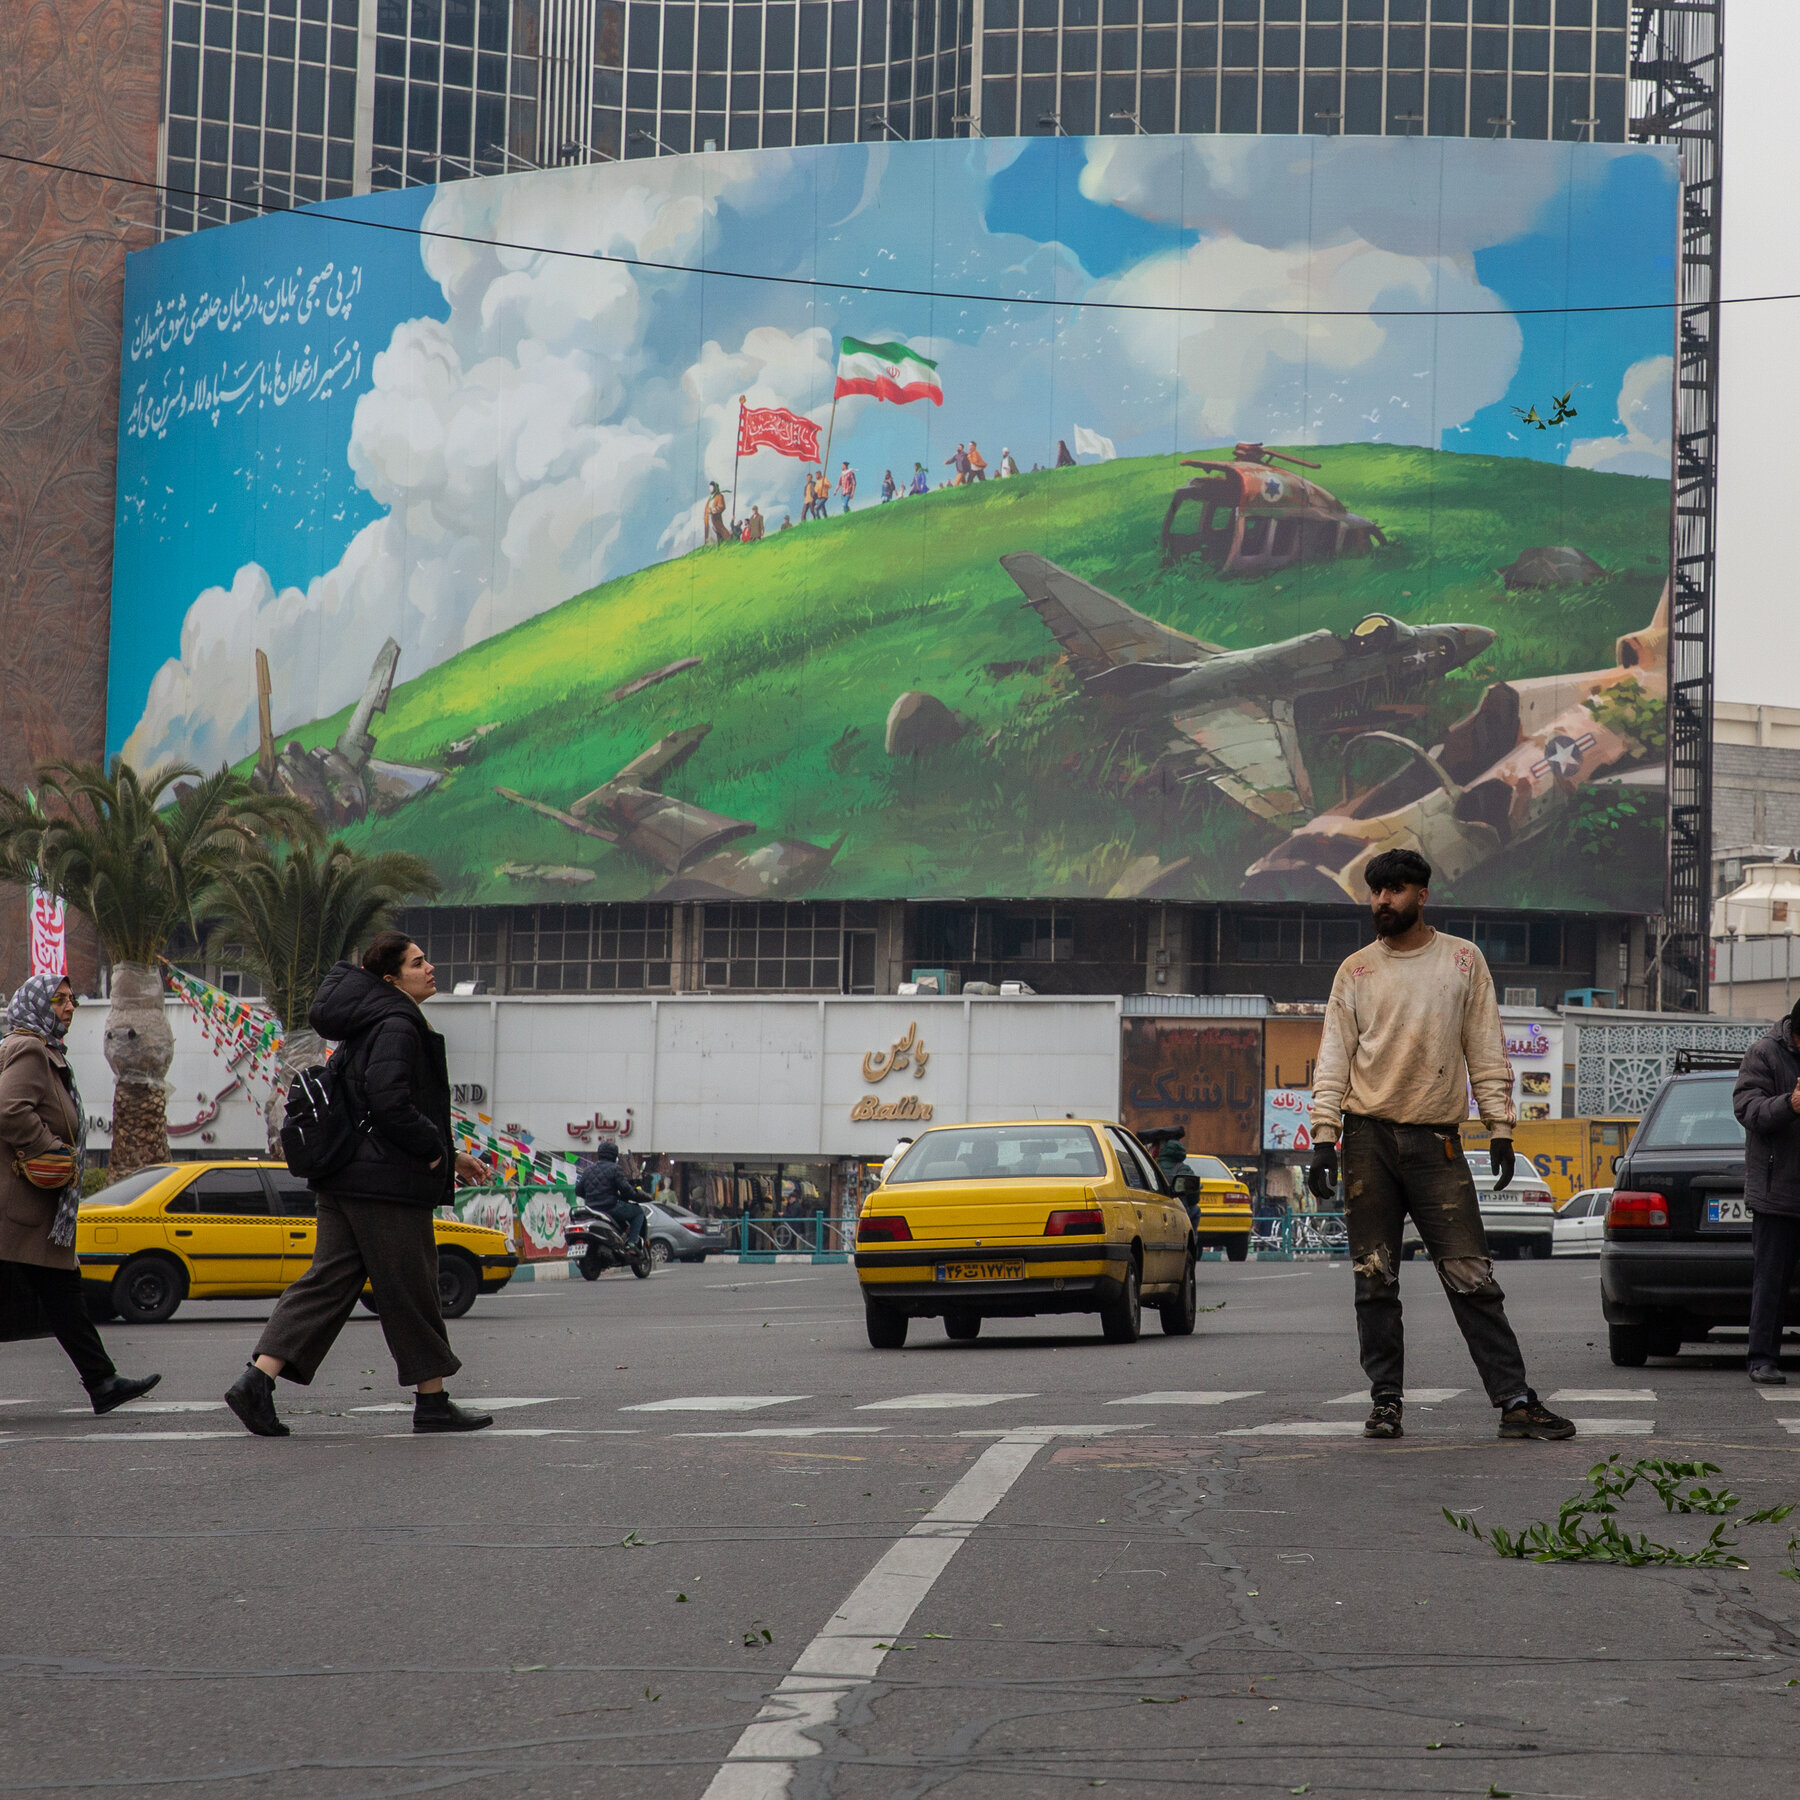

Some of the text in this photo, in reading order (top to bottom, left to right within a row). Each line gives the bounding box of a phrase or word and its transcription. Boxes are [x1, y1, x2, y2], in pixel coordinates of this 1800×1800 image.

[217, 275, 251, 332] میان
[244, 293, 258, 320] در
[297, 262, 334, 325] صبحی
[326, 271, 352, 320] پی
[346, 266, 362, 299] از
[131, 300, 166, 361] شهیدان
[161, 293, 187, 352] شوق
[308, 337, 352, 401] مسیر
[342, 340, 361, 390] از
[151, 366, 185, 440] نسرین
[178, 395, 187, 418] و
[187, 374, 207, 414] لاله
[205, 361, 263, 428] سپاه
[862, 1020, 930, 1084] بالین
[452, 1083, 485, 1103] ND
[850, 1095, 933, 1122] Balin
[1272, 1092, 1303, 1113] زنانه
[567, 1108, 632, 1143] زیبایی
